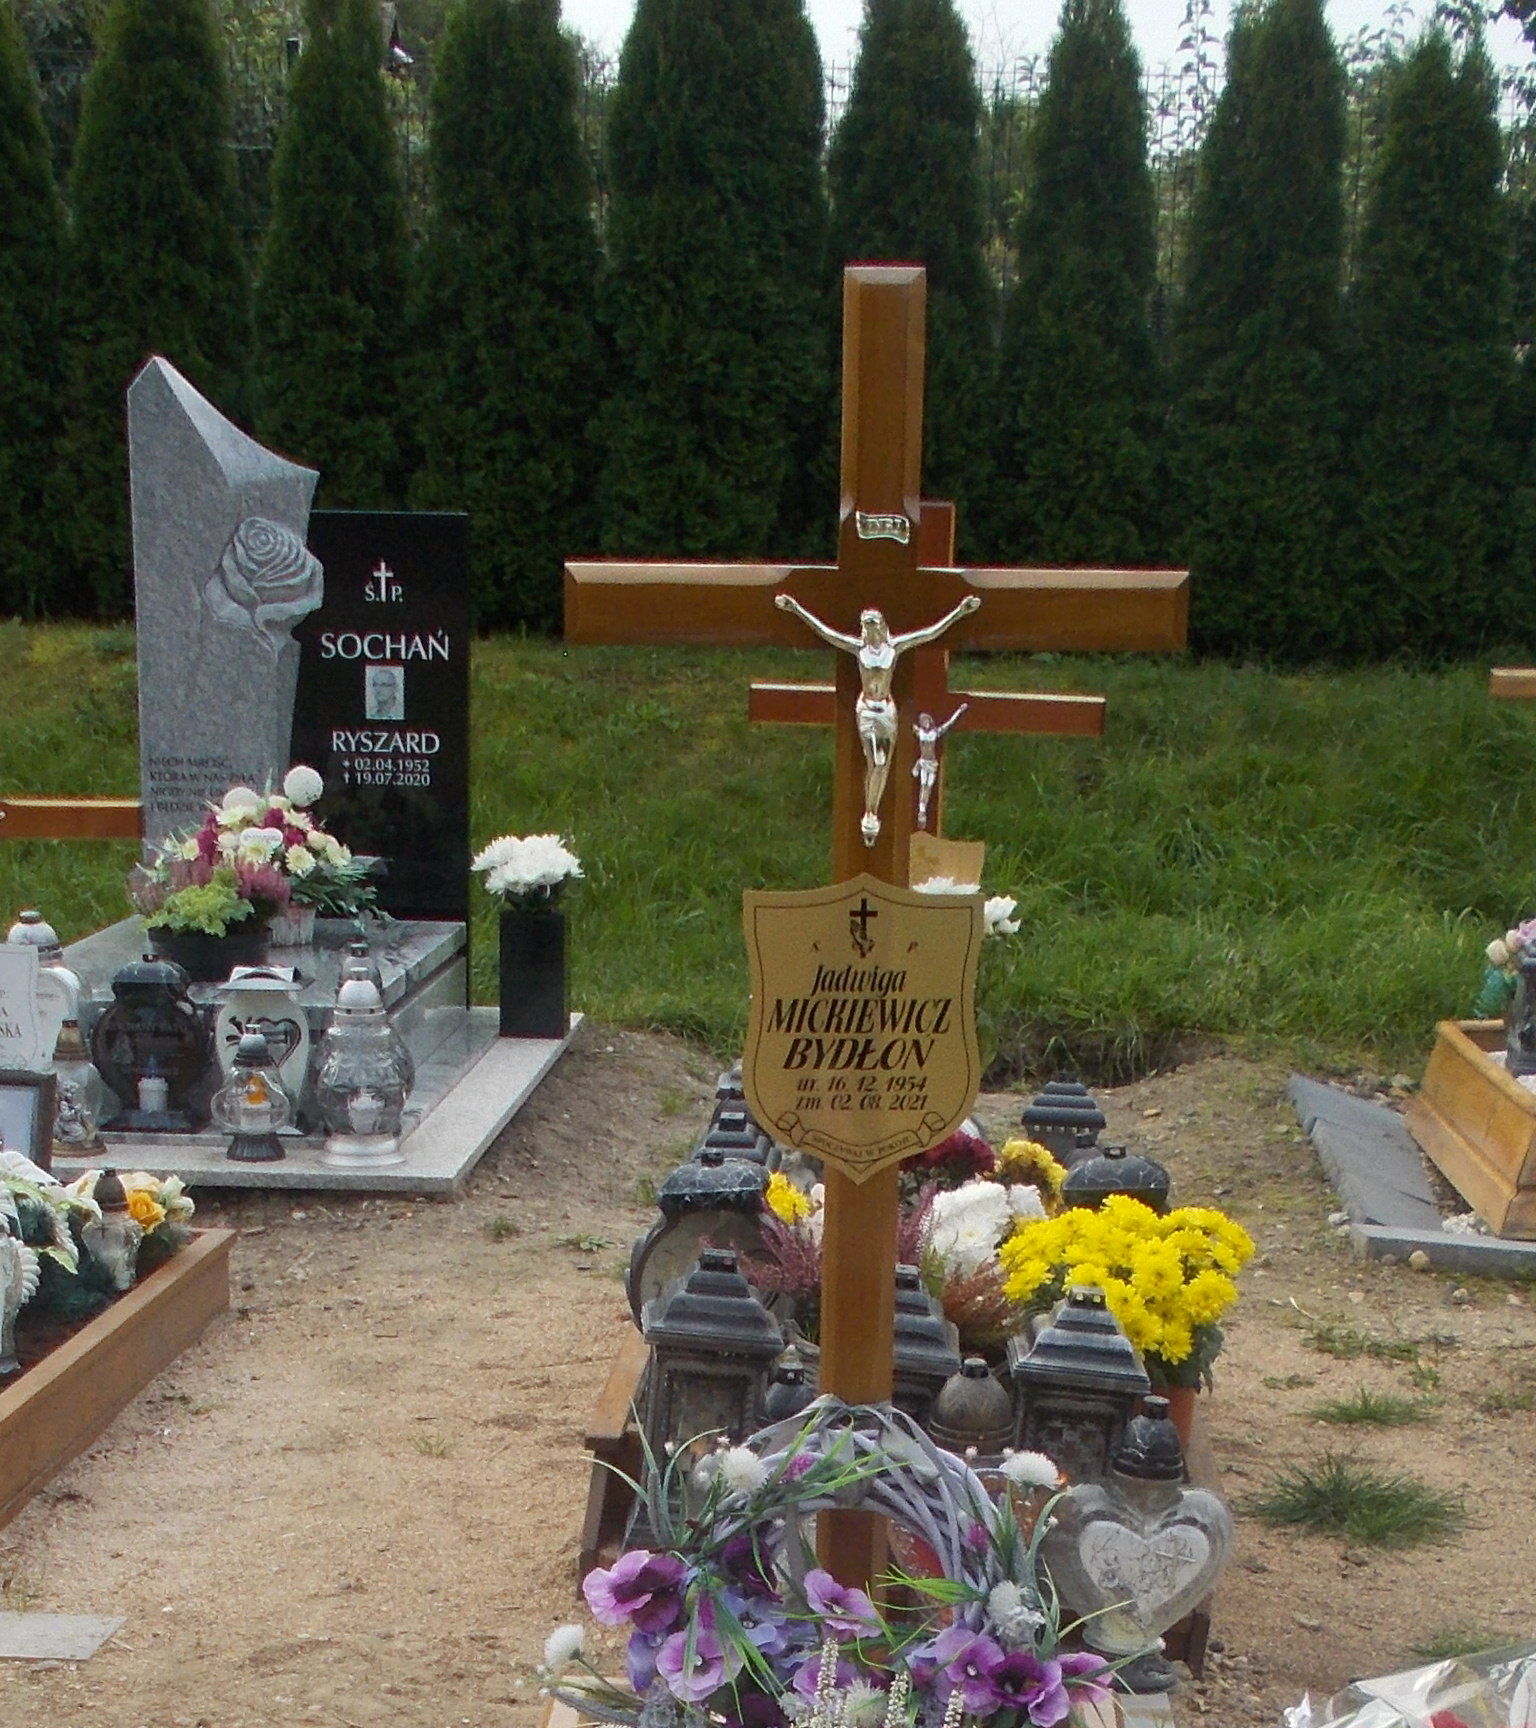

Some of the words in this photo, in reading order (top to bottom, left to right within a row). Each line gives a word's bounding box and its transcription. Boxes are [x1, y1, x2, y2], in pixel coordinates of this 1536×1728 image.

[320, 628, 450, 661] SOCHAŃ
[332, 730, 441, 754] RYSZARD
[354, 759, 431, 773] 02.04.1952
[355, 772, 431, 787] 19.07.2020
[811, 964, 908, 997] Jadwiga
[766, 998, 953, 1034] MICKIEWICZ
[885, 1076, 928, 1092] 1954
[888, 1095, 929, 1111] 2021
